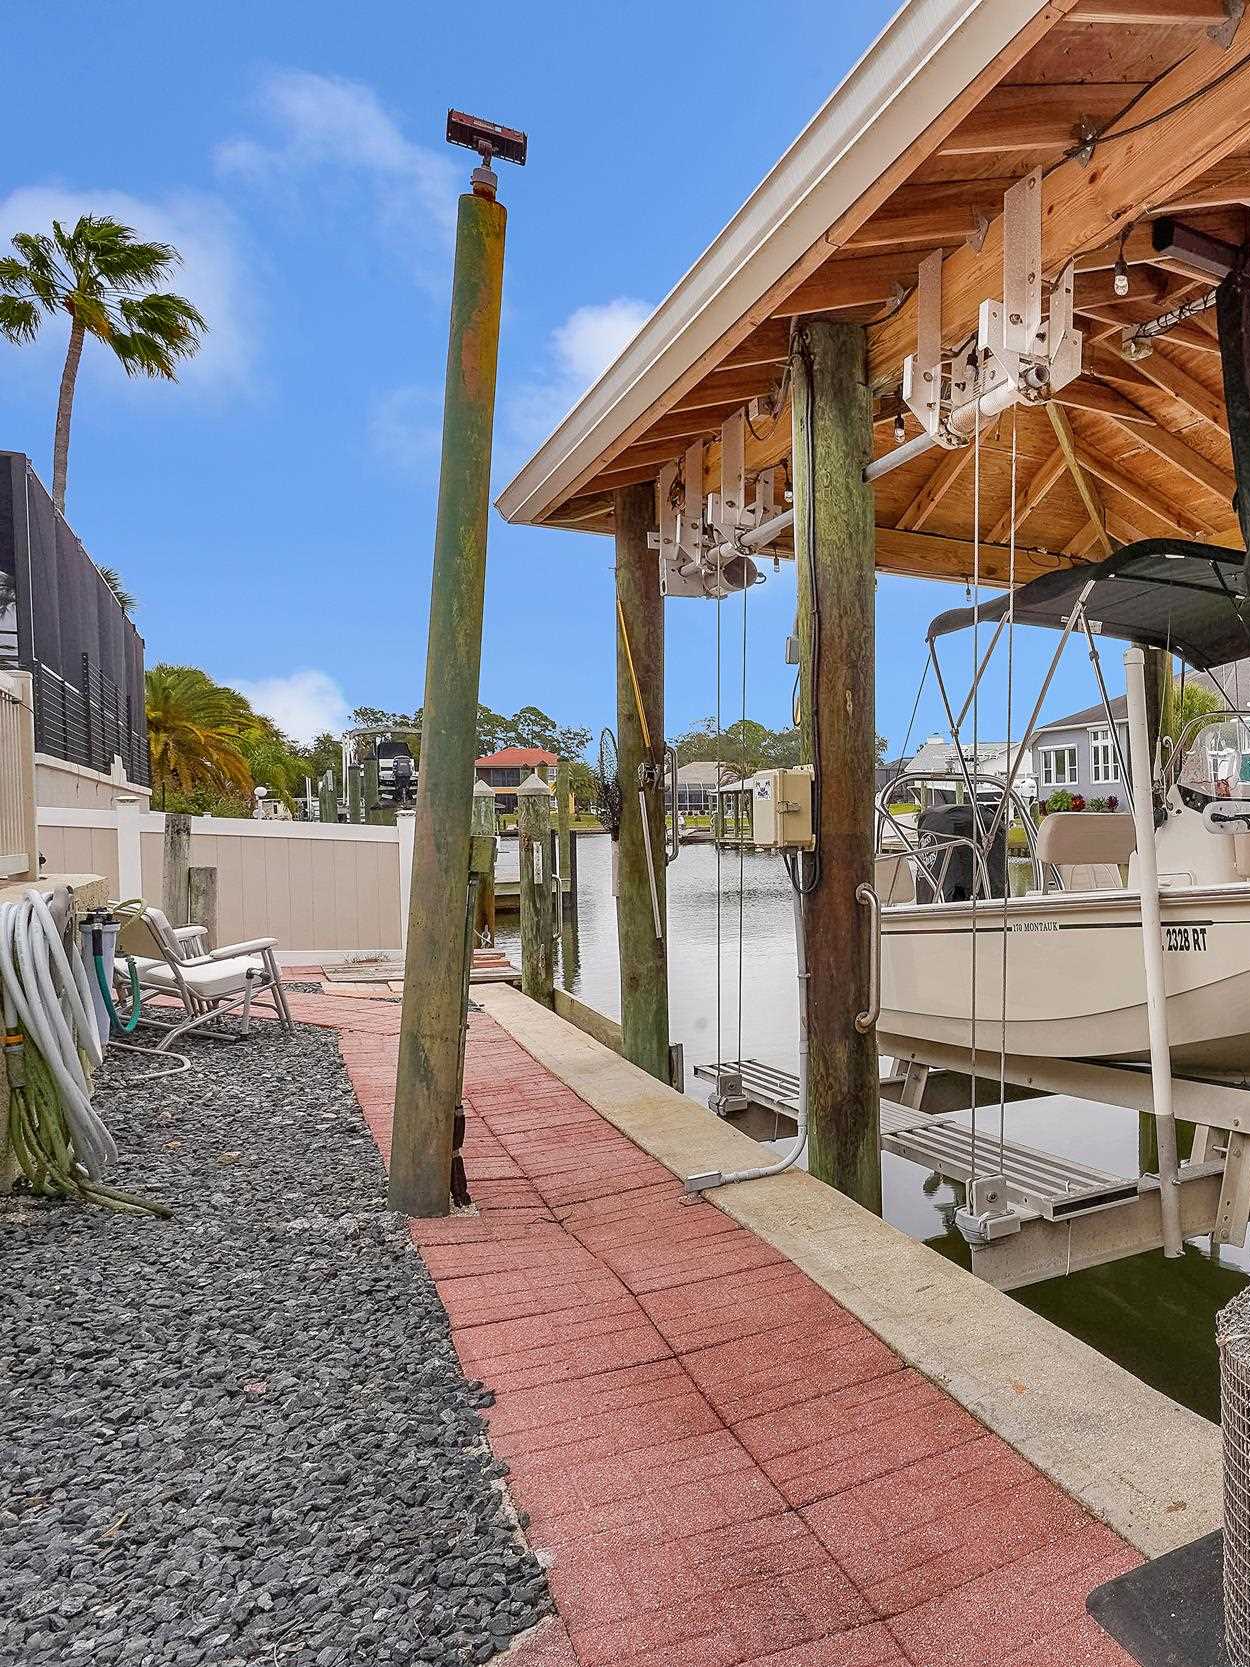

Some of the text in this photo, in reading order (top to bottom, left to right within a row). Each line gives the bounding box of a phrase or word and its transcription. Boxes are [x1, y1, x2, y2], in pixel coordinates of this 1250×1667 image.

[1024, 922, 1058, 931] MONTAUK
[1166, 928, 1207, 951] 2328 RT
